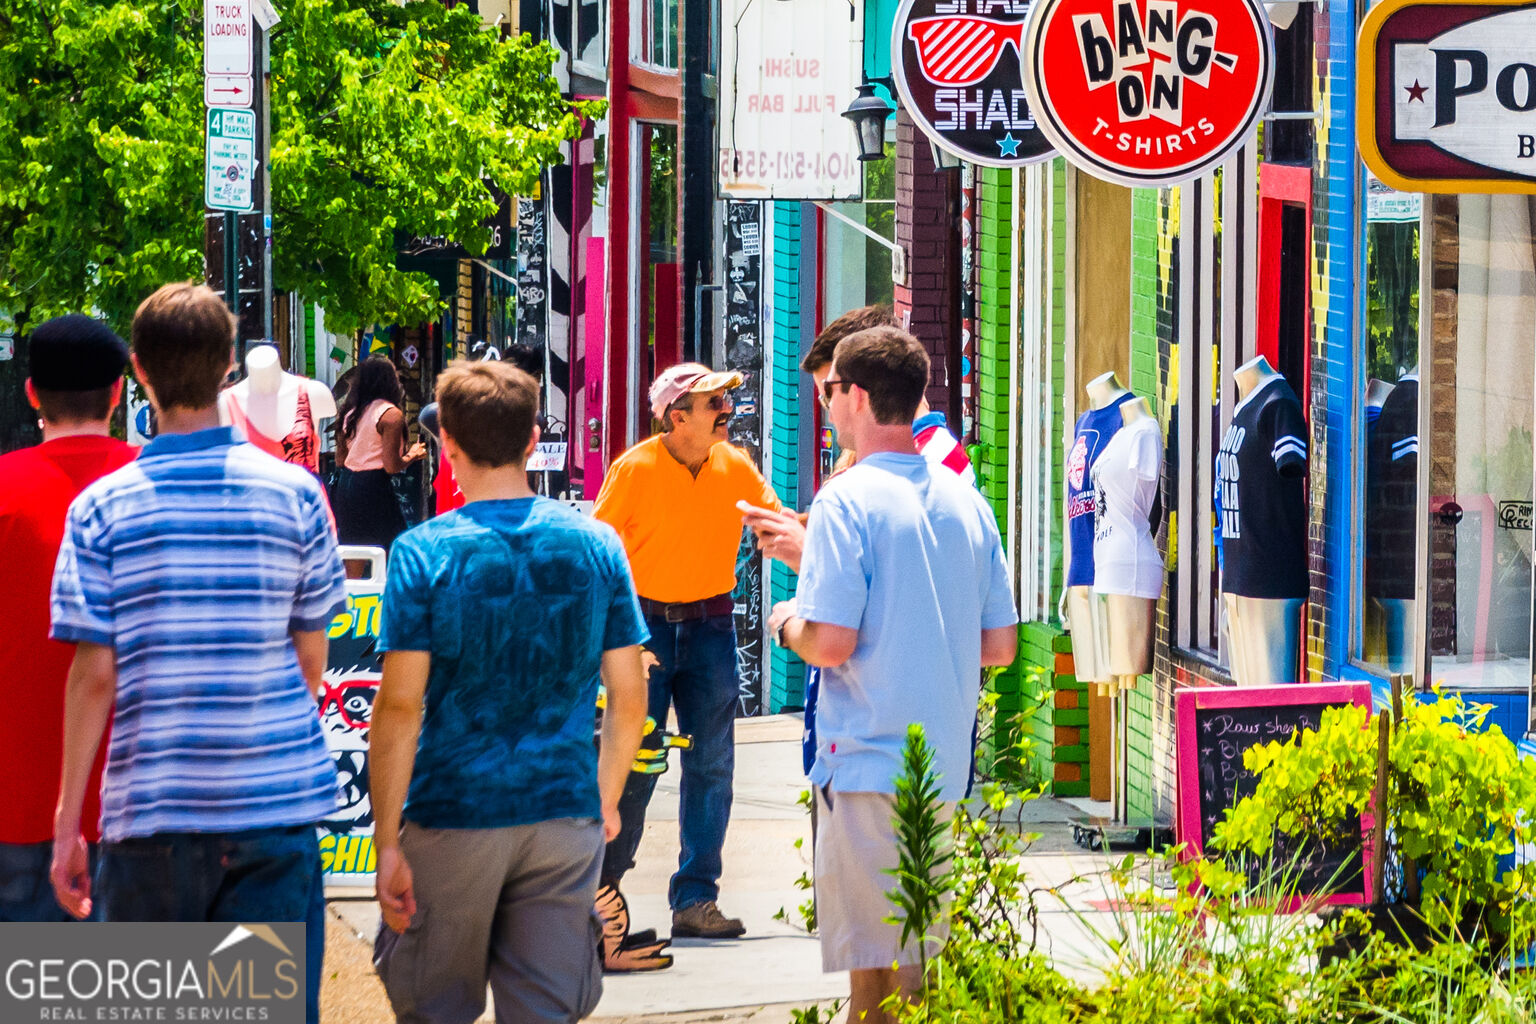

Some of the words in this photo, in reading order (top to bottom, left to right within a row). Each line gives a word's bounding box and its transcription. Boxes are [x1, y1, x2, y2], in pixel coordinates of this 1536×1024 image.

[215, 5, 242, 18] TRUCK
[210, 23, 247, 37] LOADING
[1118, 74, 1180, 118] ON
[210, 112, 221, 134] 4
[225, 125, 251, 136] PARKING
[1092, 117, 1215, 156] T-SHIRTS
